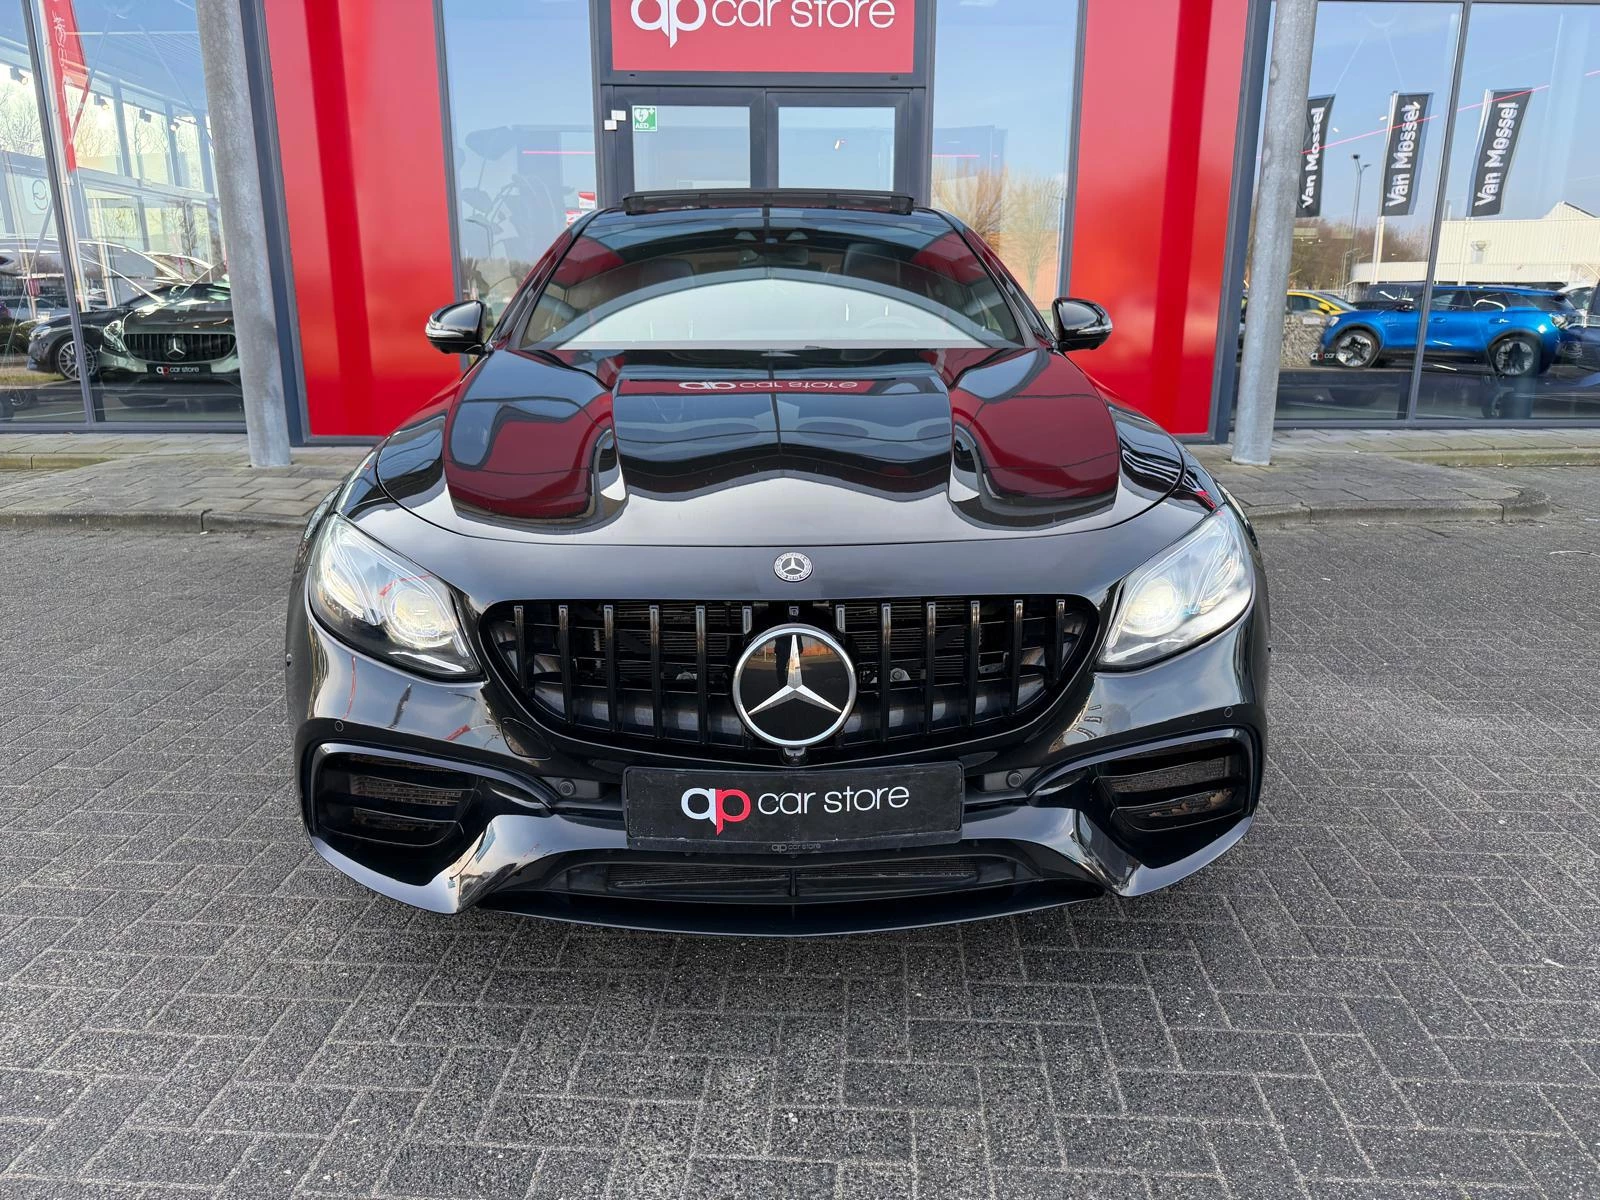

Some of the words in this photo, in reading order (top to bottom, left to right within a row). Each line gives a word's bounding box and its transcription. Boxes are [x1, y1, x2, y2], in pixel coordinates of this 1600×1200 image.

[712, 0, 781, 27] car
[790, 0, 896, 28] store
[1305, 107, 1325, 171] Mossel
[1391, 104, 1421, 168] Mossel
[1485, 102, 1519, 168] Mossel
[1302, 175, 1316, 208] Van
[1385, 173, 1410, 207] Van
[1474, 172, 1501, 206] Van
[758, 792, 816, 815] car
[823, 786, 910, 813] store
